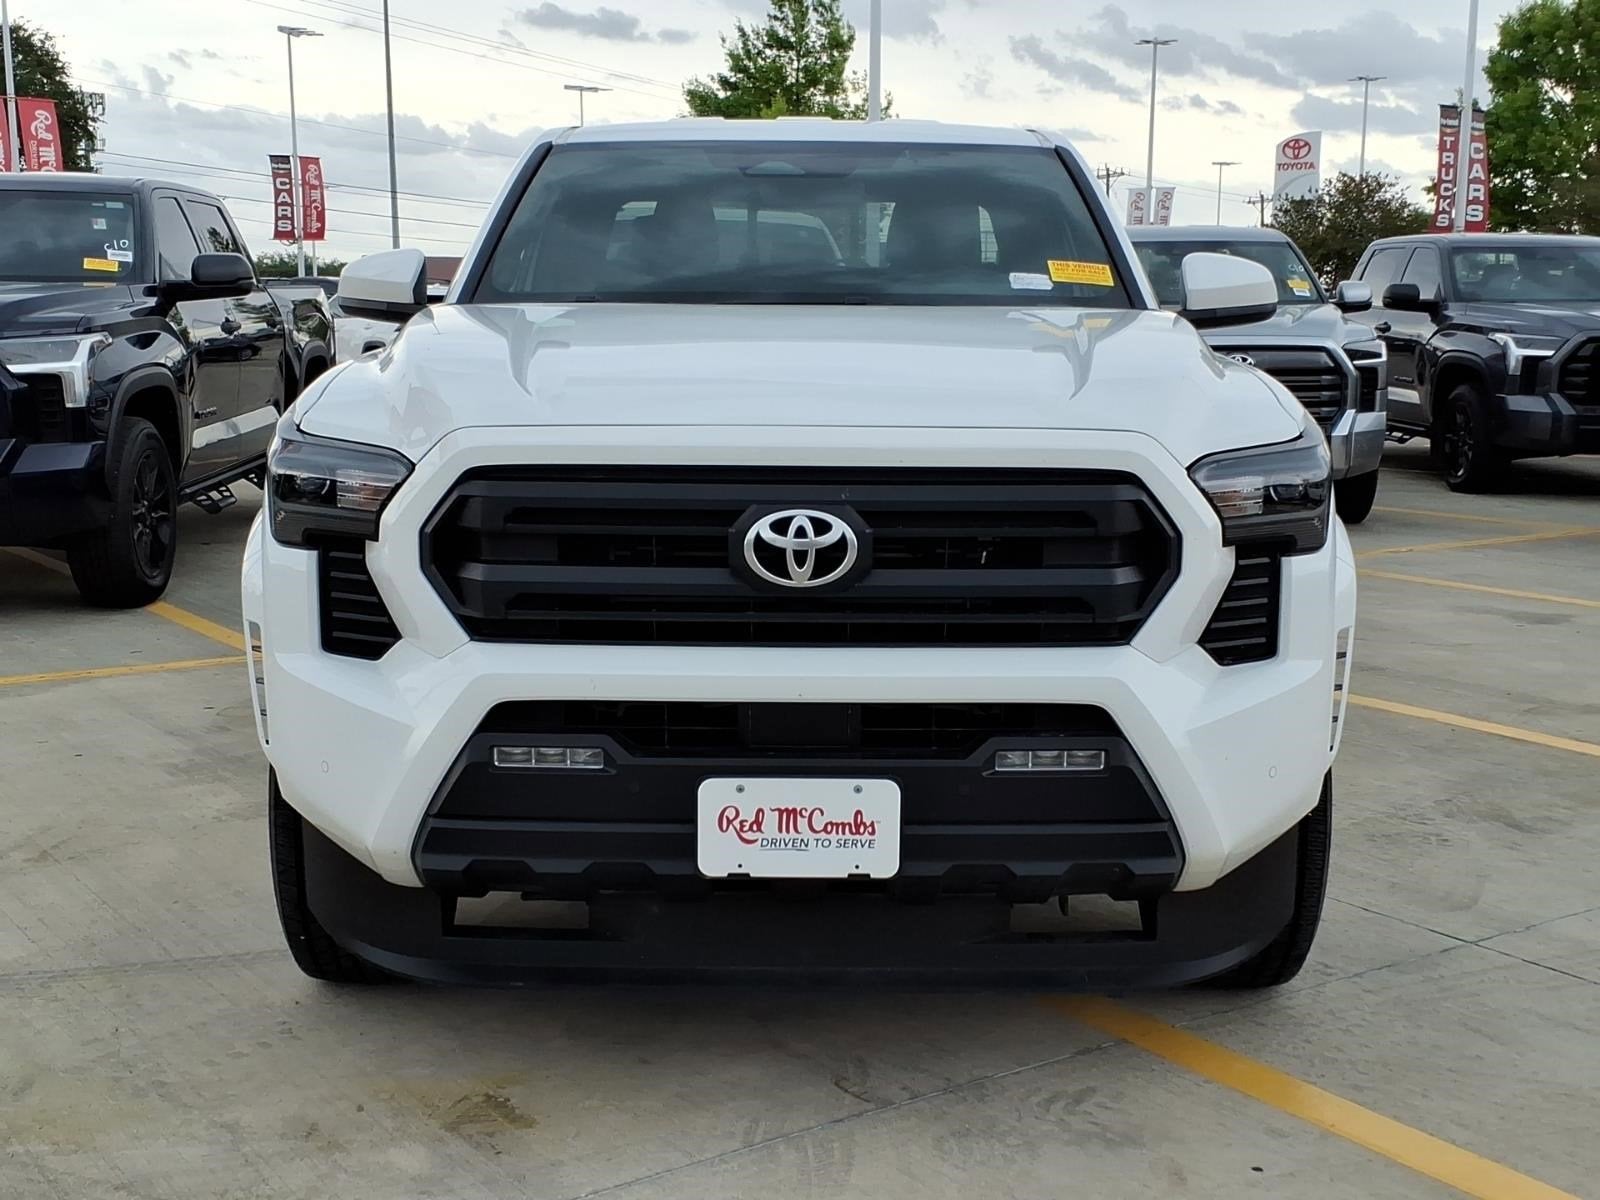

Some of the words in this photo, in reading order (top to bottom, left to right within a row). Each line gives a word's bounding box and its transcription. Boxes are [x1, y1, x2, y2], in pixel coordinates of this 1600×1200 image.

[31, 109, 53, 140] Red
[305, 164, 320, 186] Red
[1276, 161, 1316, 171] TOYOTA
[1436, 136, 1455, 227] TRUCKS
[1466, 142, 1485, 222] CARS
[275, 178, 293, 231] CARS
[717, 805, 766, 845] Red
[769, 807, 877, 837] McCombs
[760, 837, 809, 848] DRIVEN
[814, 838, 832, 848] TO
[835, 838, 876, 849] SERVE
